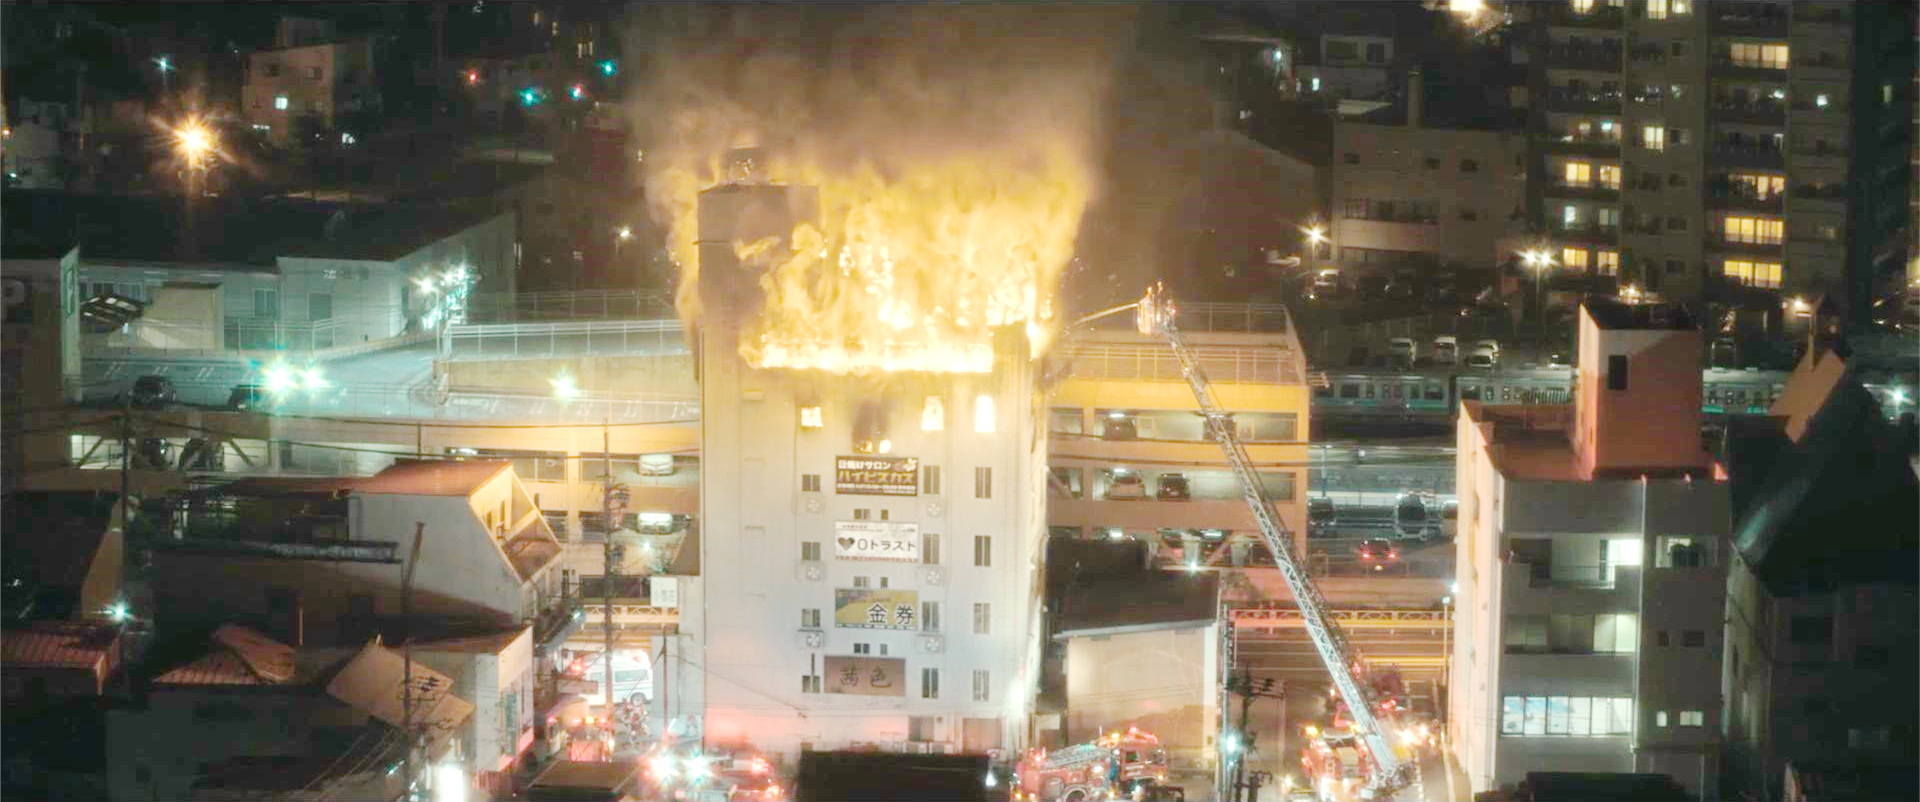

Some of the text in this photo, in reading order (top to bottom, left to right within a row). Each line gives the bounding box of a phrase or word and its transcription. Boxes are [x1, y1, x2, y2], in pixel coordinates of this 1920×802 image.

[838, 459, 892, 470] 日焼けサロン
[838, 470, 914, 484] ハイビスカス
[868, 603, 915, 625] 金券
[840, 664, 893, 688] 茜色
